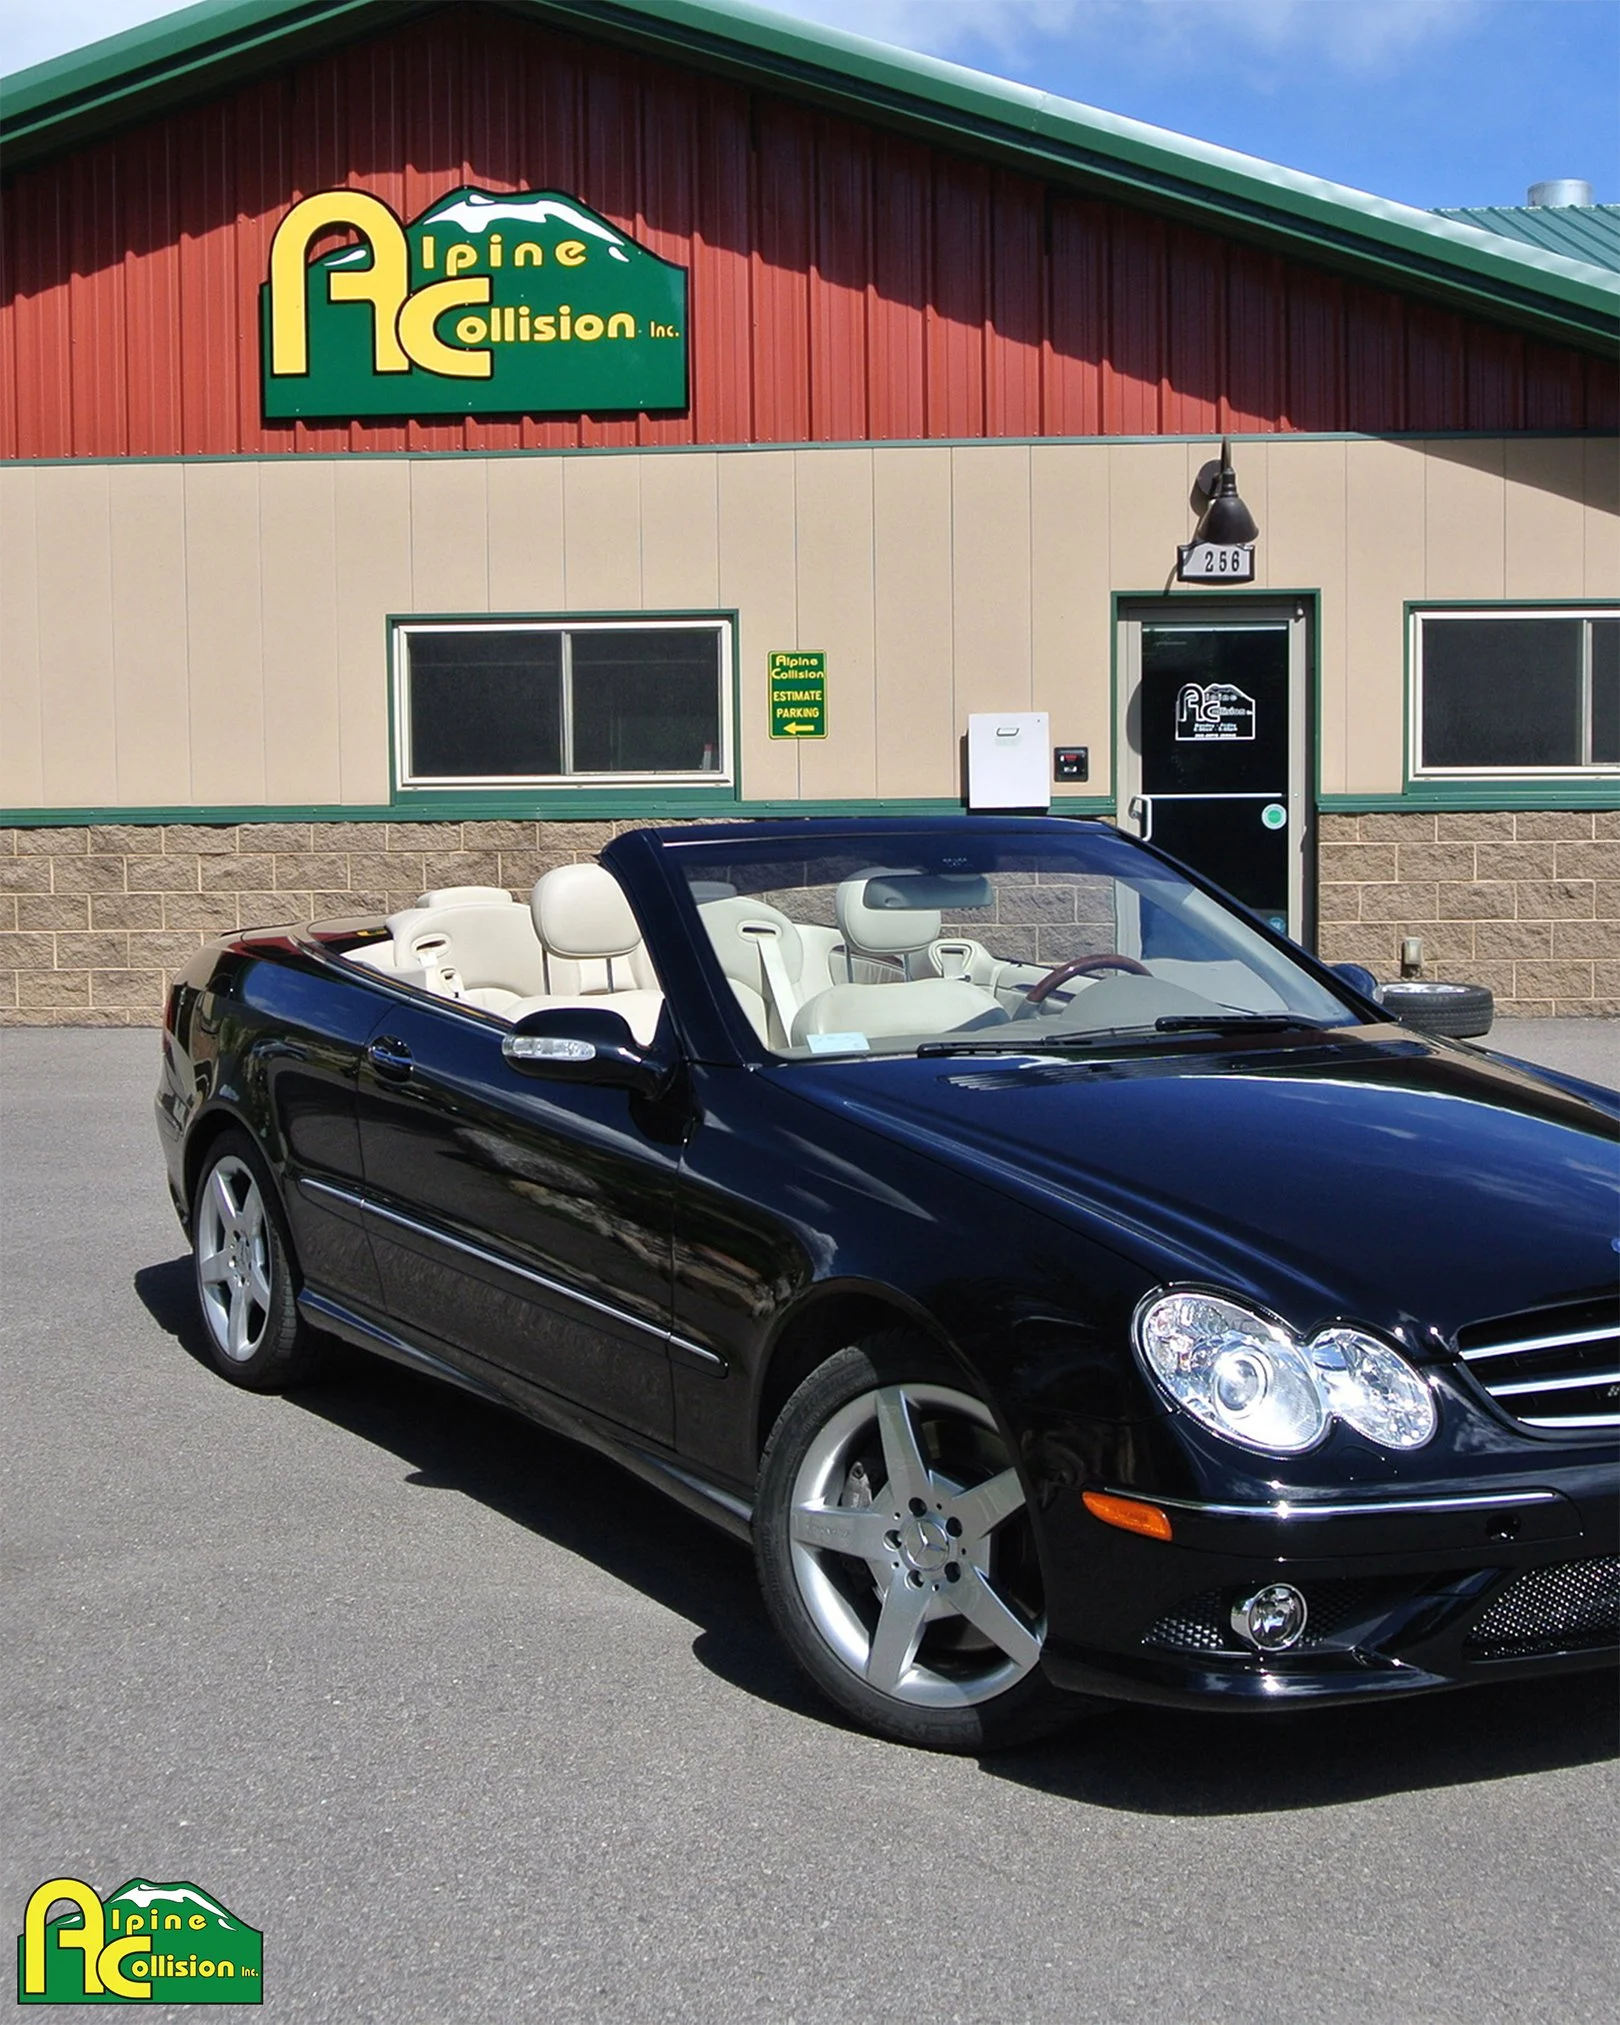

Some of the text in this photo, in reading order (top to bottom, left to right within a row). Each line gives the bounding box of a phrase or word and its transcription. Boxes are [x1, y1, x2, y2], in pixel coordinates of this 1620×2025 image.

[271, 190, 586, 375] Alpine
[398, 276, 680, 378] Collision Inc.
[1205, 550, 1240, 572] 256
[775, 655, 819, 668] Alpine
[771, 667, 824, 679] Collision
[773, 690, 822, 702] ESTIMATE
[776, 707, 819, 718] PARKING
